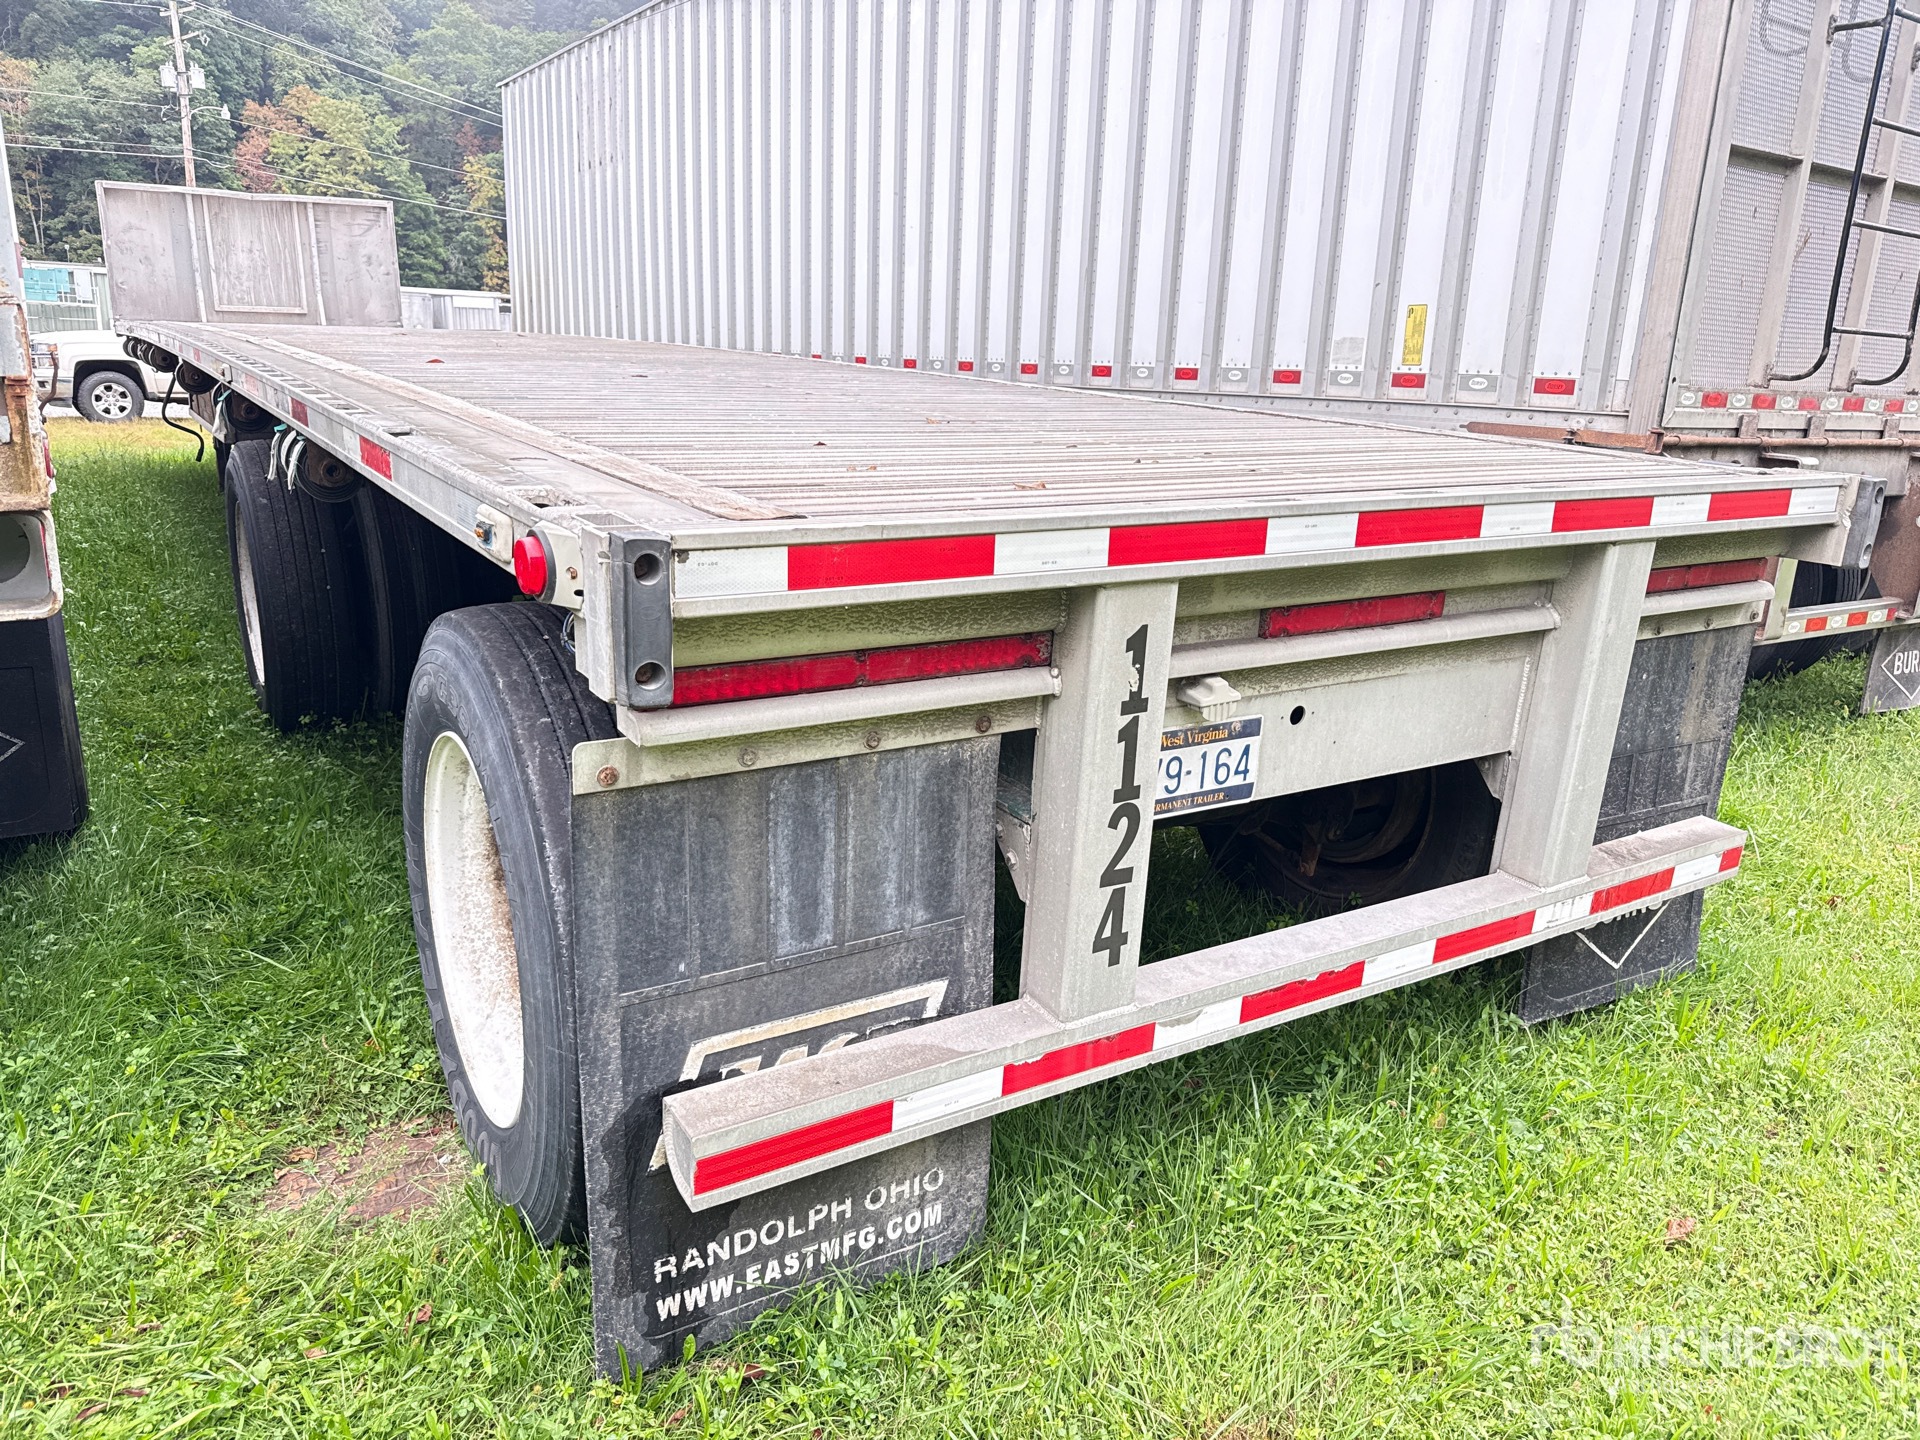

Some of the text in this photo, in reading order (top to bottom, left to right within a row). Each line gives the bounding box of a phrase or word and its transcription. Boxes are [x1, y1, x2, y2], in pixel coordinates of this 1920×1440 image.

[1893, 650, 1920, 675] BUR
[1187, 725, 1229, 745] Virginia
[1158, 743, 1251, 794] 9-164
[1092, 624, 1149, 967] 1124
[1154, 792, 1225, 812] RMANENT TRAILER
[653, 1166, 944, 1284] RANDOLPH OHIO
[656, 1203, 943, 1322] WWW.EASTMFG.COM
